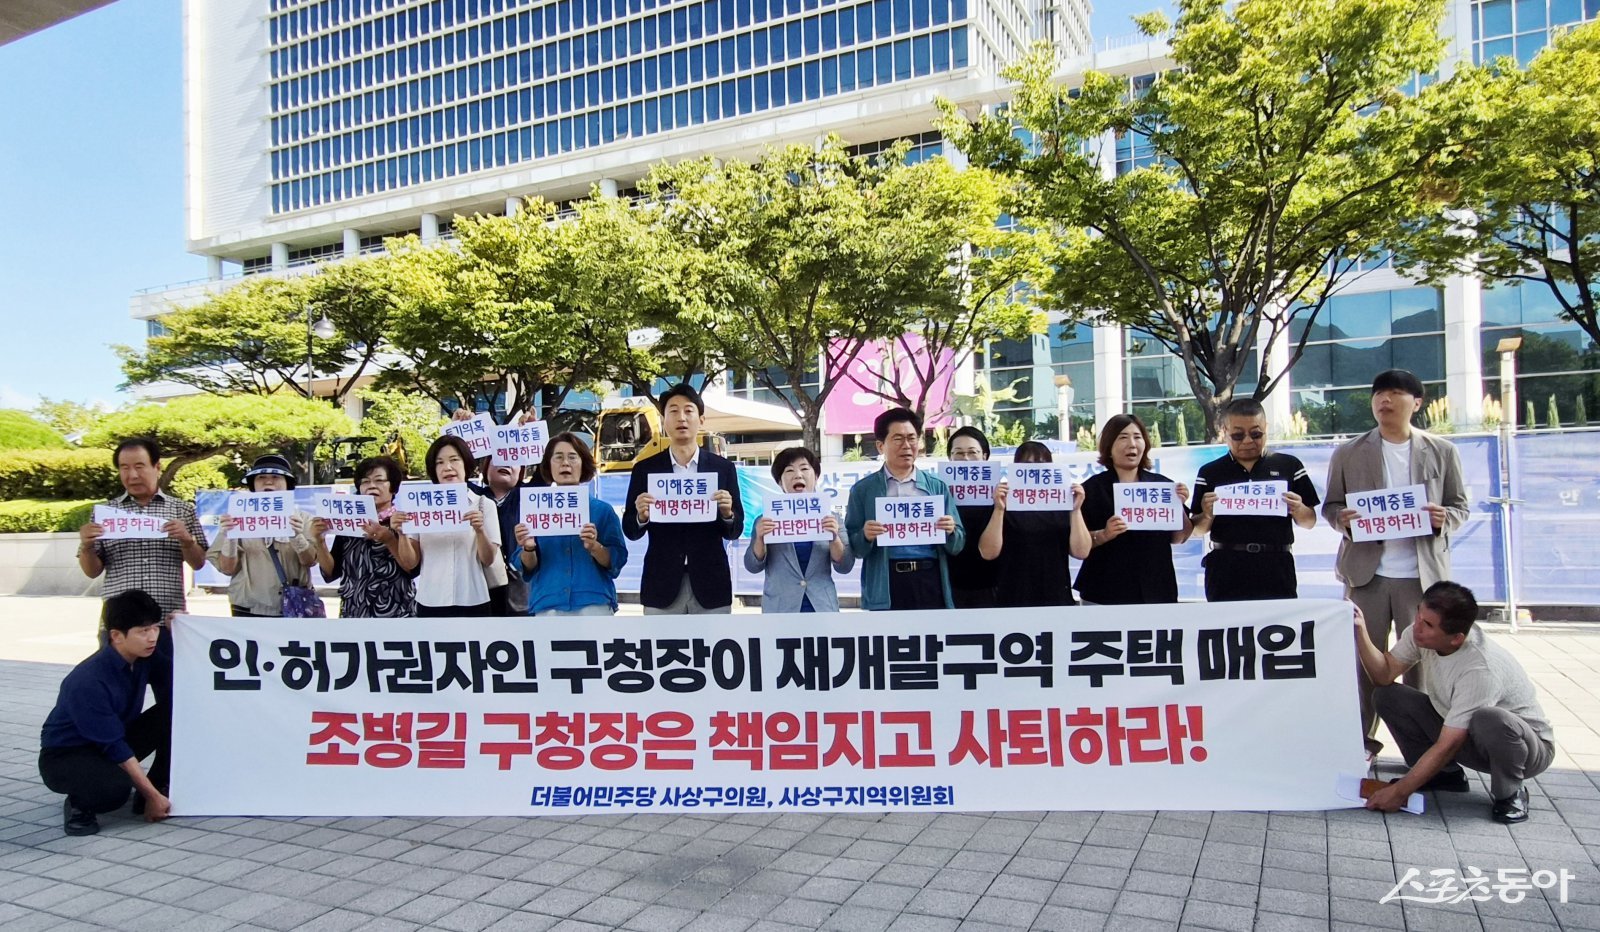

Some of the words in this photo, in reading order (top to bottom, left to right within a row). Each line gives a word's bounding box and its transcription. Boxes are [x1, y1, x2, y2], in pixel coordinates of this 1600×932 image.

[497, 427, 541, 443] 이해충돌
[497, 445, 545, 461] 해명하라!
[945, 466, 992, 481] 이해충돌
[1015, 468, 1063, 484] 이해충돌
[657, 478, 708, 495] 이해충돌
[408, 489, 458, 507] 이해충돌
[528, 492, 579, 509] 이해충돌
[1012, 488, 1066, 504] 해명하라!
[1123, 488, 1172, 503] 이해충돌
[1356, 491, 1416, 513] 이해충돌
[236, 496, 284, 512] 이해충돌
[322, 499, 367, 515] 이해충돌
[654, 500, 710, 516] 해명하라!
[771, 498, 821, 516] 투기의혹
[885, 502, 935, 518] 이해충돌
[1220, 498, 1280, 510] 해명하라!
[407, 510, 463, 527] 해명하라!
[525, 513, 582, 530] 해명하라!
[1121, 507, 1175, 523] 해명하라!
[102, 518, 160, 533] 해명하라!
[883, 522, 938, 539] 해명하라!
[1356, 513, 1422, 535] 해명하라!
[209, 638, 539, 694] 인·허가권자인
[550, 637, 763, 694] 구청장이
[775, 631, 1053, 692] 재개발구역
[1068, 628, 1185, 688] 주택
[1197, 620, 1317, 681] 매입
[306, 711, 467, 769] 조병길
[480, 711, 697, 771] 구청장은
[709, 710, 936, 771] 책임지고
[949, 703, 1208, 768] 사퇴하라!
[530, 785, 656, 808] 더불어민주당
[659, 785, 773, 808] 사상구의원,
[778, 785, 955, 808] 사상구지역위원회
